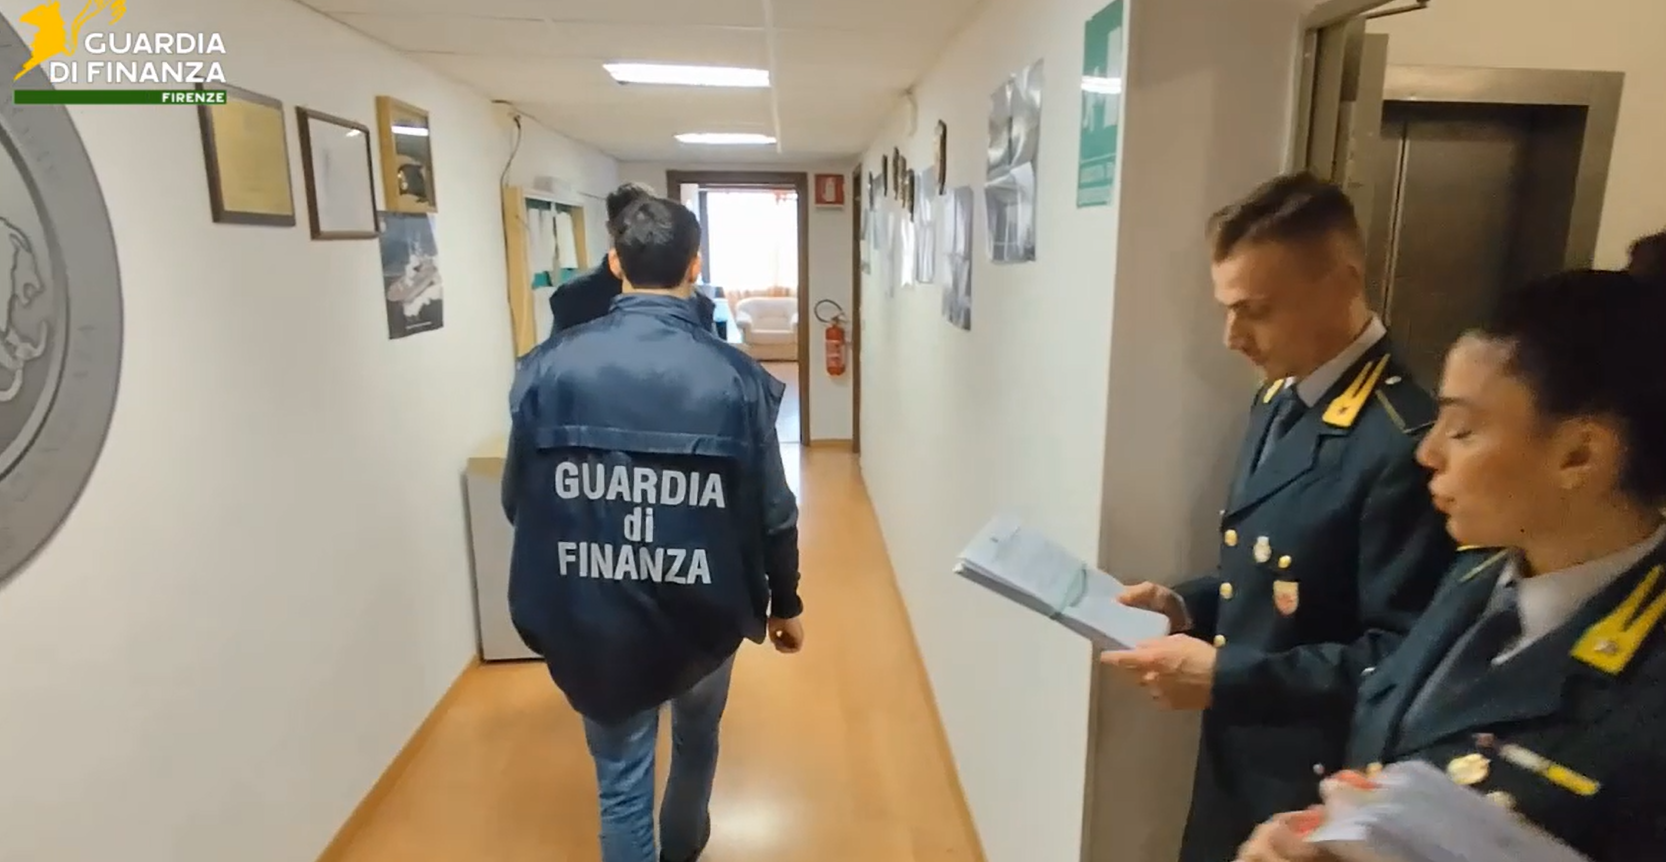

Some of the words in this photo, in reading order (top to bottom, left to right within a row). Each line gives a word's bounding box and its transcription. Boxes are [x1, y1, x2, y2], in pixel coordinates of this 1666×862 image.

[555, 461, 726, 509] GUARDIA
[623, 506, 654, 543] di
[557, 541, 712, 585] FINANZA
